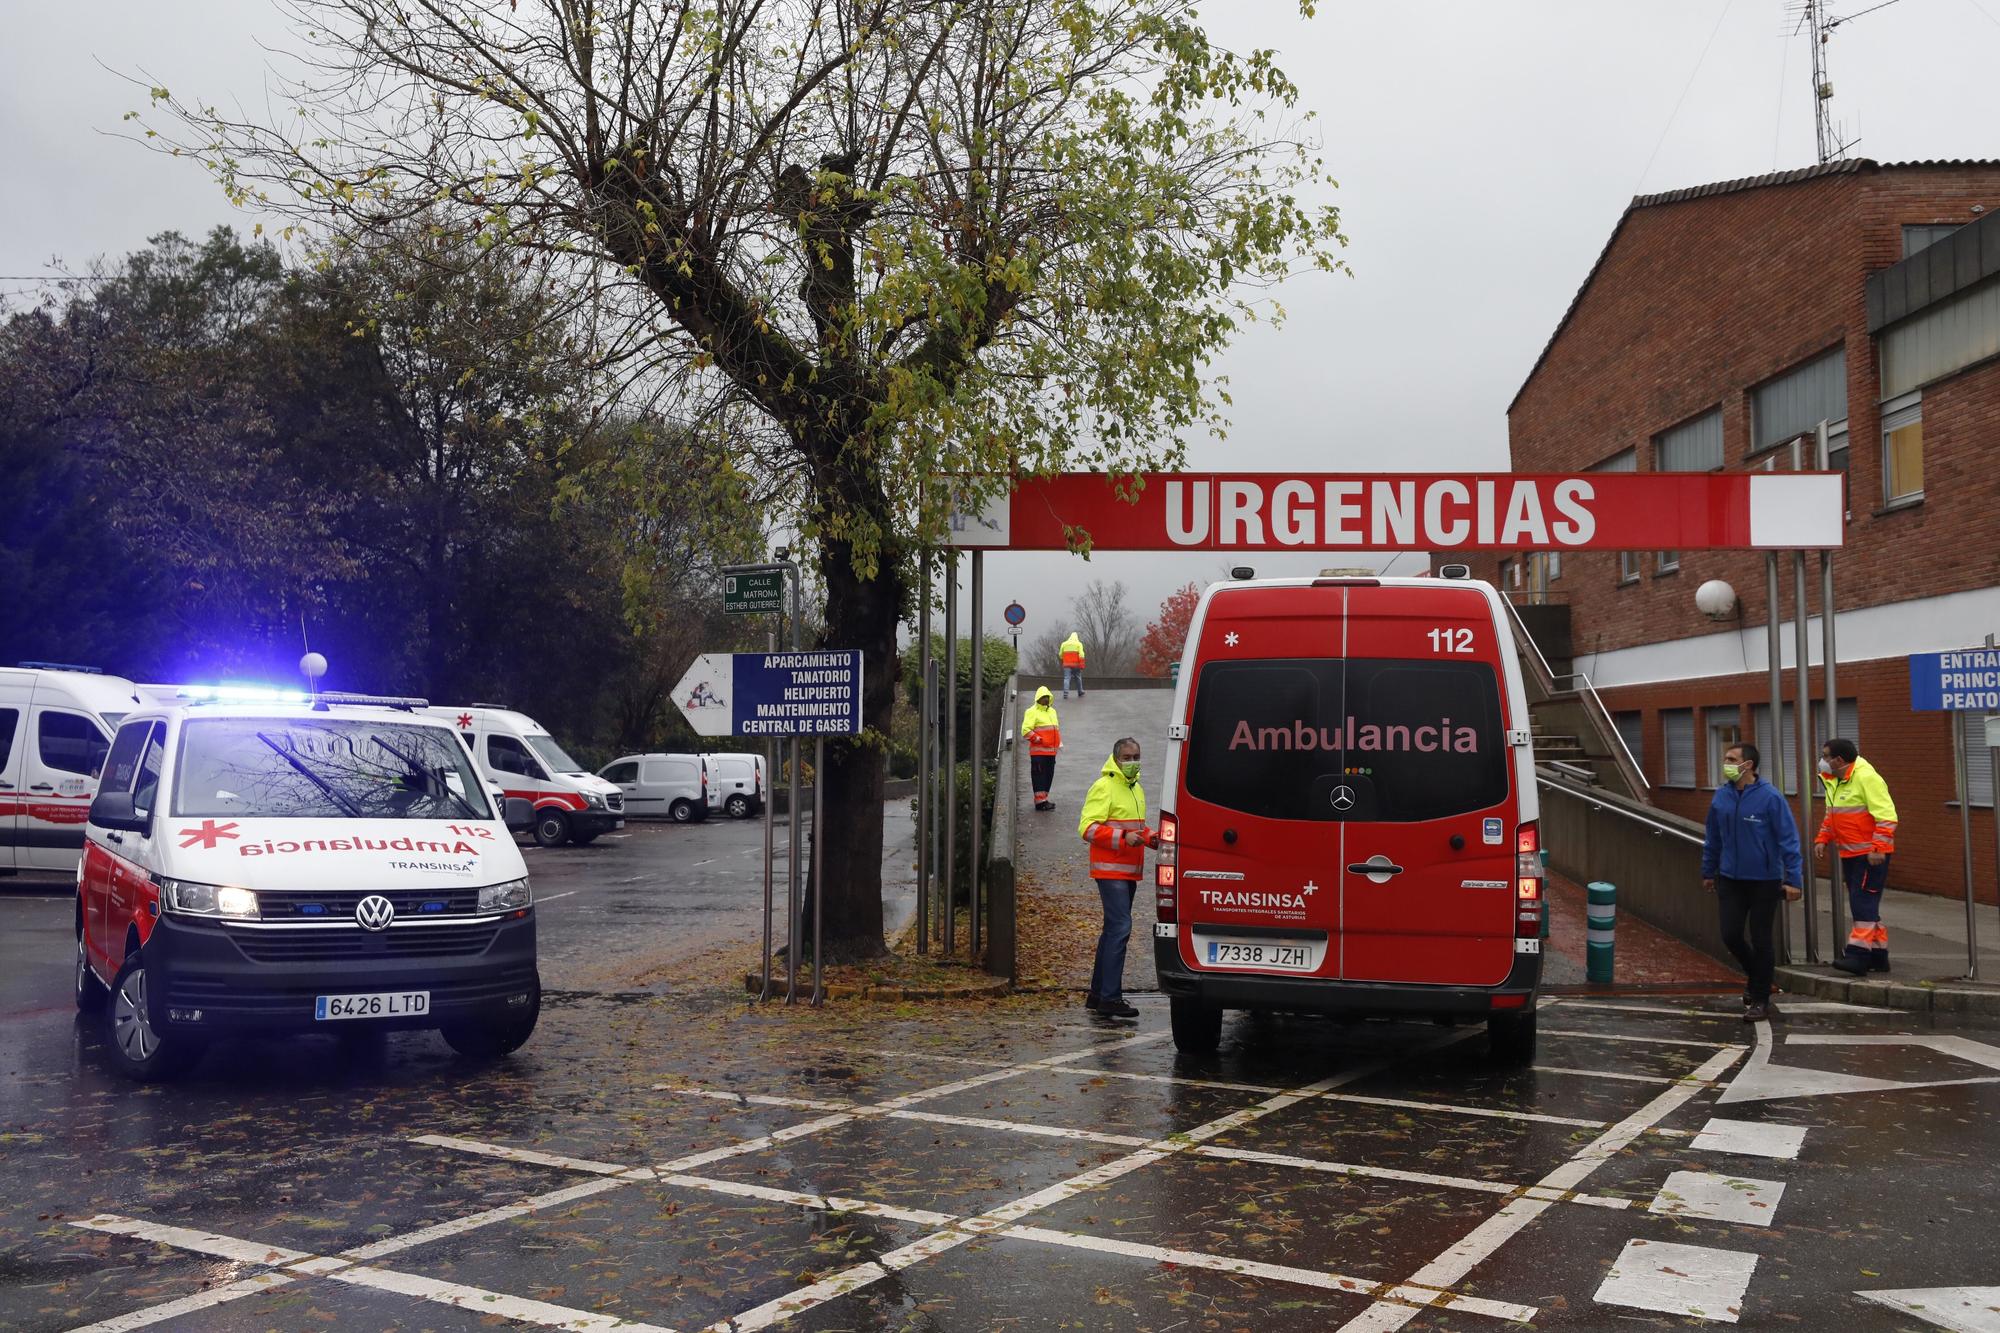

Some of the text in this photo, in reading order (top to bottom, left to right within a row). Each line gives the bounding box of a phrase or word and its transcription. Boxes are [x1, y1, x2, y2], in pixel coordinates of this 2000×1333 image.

[1164, 479, 1597, 546] URGENCIAS
[748, 578, 771, 587] CALLE
[743, 590, 778, 599] MATRONA
[725, 601, 748, 611] ESTHER
[1427, 628, 1474, 653] 112
[764, 653, 851, 668] APARCAMIENTO
[791, 670, 851, 683] TANATORIO
[784, 686, 851, 700] HELIPUERTO
[757, 703, 851, 717] MANTENIMIENTO
[742, 719, 850, 733] CENTRAL DE GASES
[1228, 716, 1478, 753] Ambulancia
[446, 824, 496, 841] 112
[388, 861, 472, 872] TRANSINSA
[1200, 891, 1306, 908] TRANSINSA
[1220, 945, 1304, 966] 7338 JZH
[330, 994, 425, 1016] 6426 LTD
